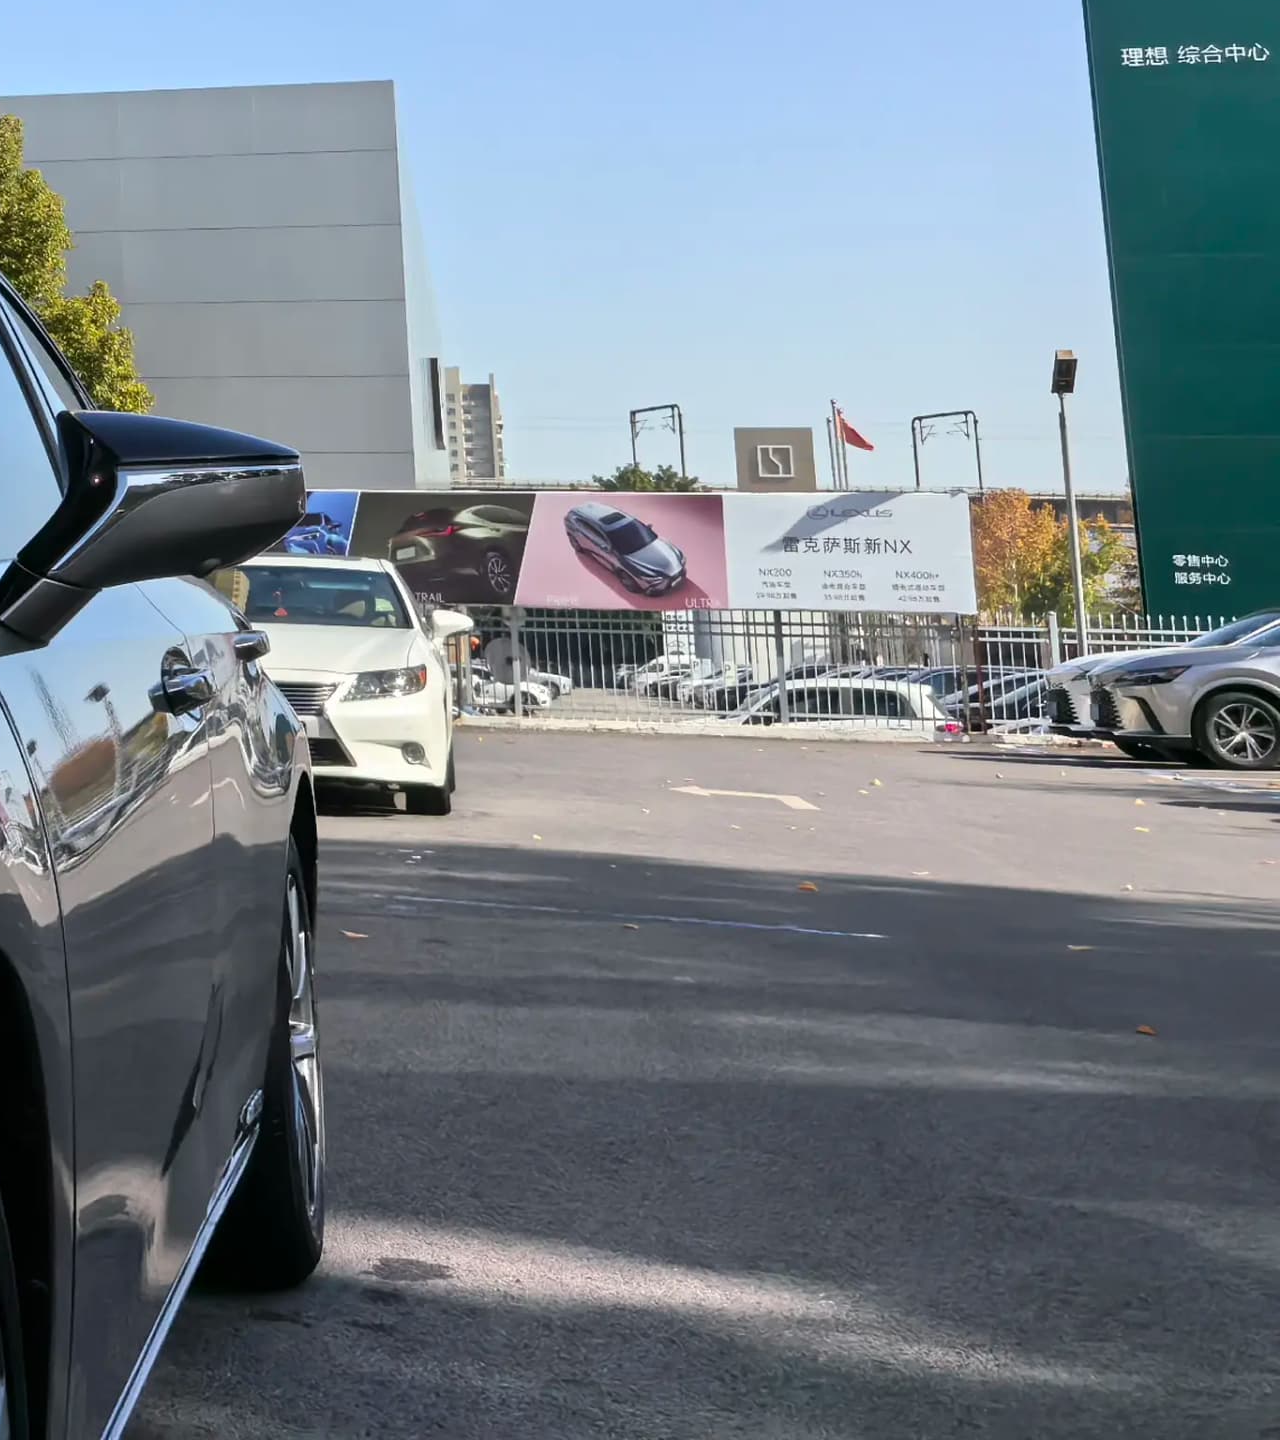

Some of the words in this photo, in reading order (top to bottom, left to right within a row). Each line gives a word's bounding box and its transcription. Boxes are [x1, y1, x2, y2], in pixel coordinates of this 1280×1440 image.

[1120, 46, 1169, 67] 理想
[1177, 42, 1270, 65] 综合中心
[830, 509, 893, 519] LEXUS
[783, 536, 913, 555] 雷克萨斯新NX
[1172, 554, 1229, 568] 零售中心
[823, 570, 862, 579] NX350h
[1175, 571, 1231, 585] 服务中心
